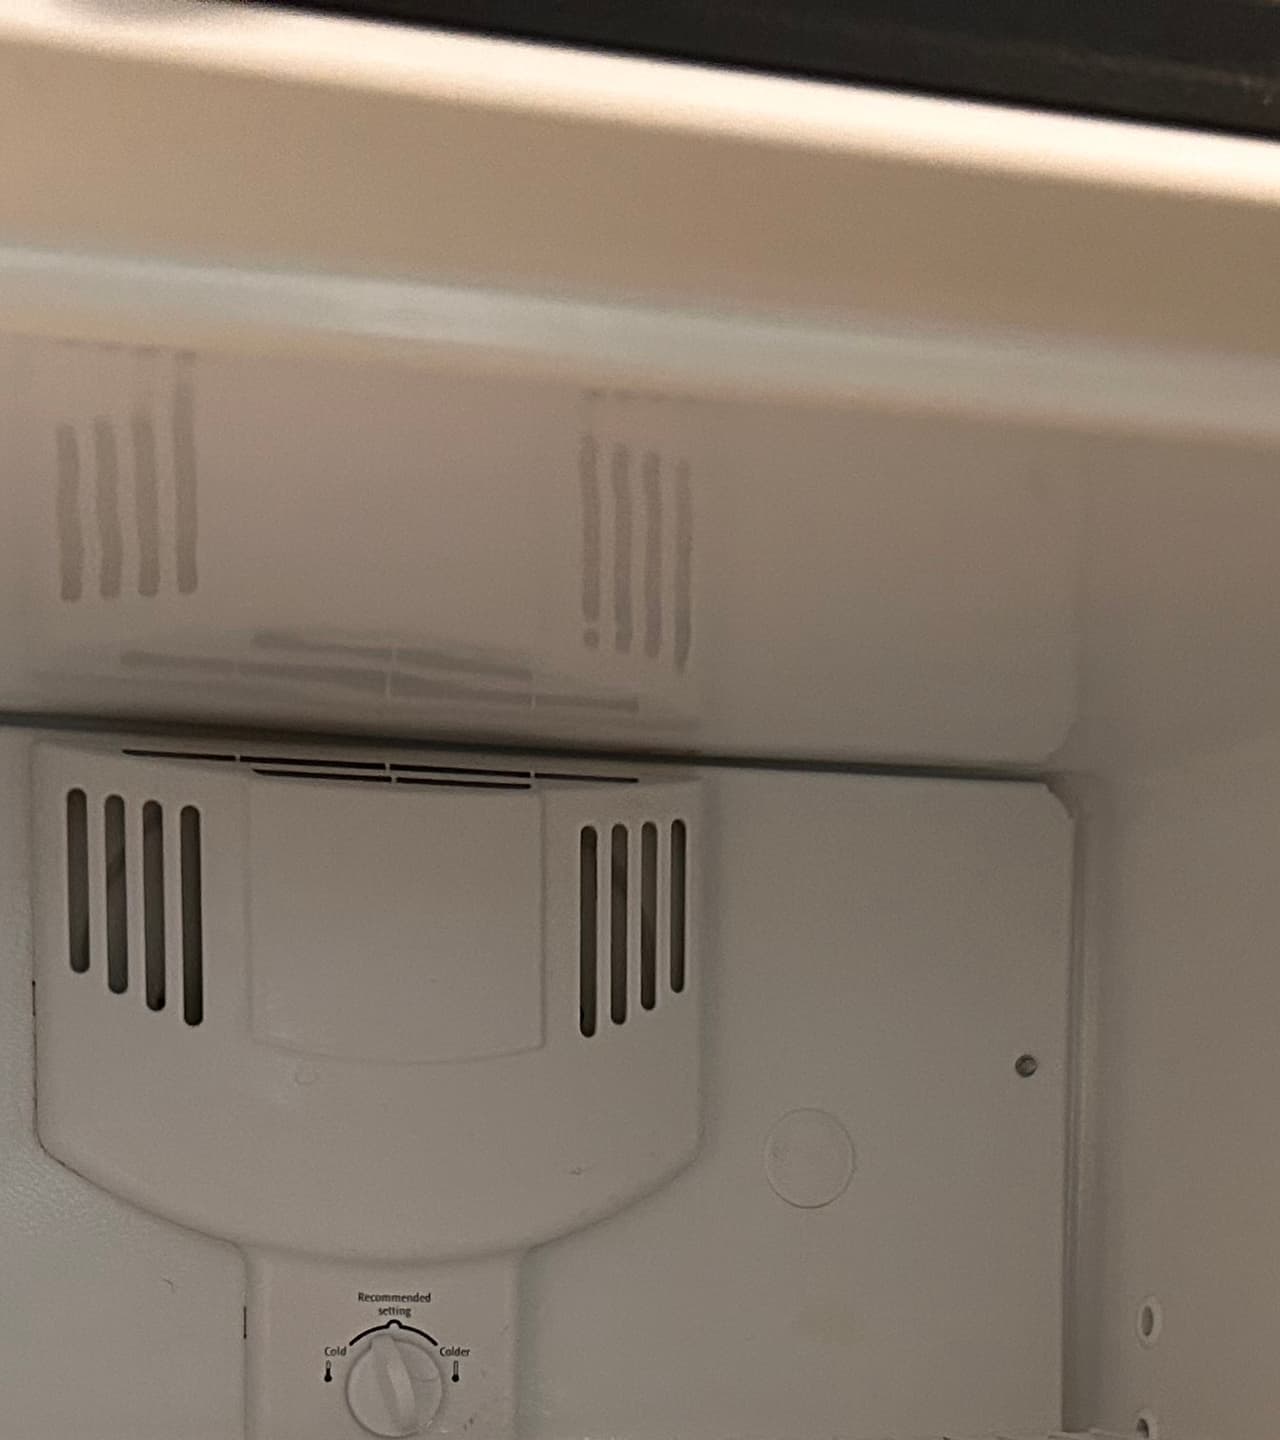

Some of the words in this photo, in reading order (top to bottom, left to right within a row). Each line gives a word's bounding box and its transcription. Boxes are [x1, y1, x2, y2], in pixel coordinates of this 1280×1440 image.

[358, 1292, 431, 1303] Recommended
[378, 1306, 411, 1317] setting
[324, 1347, 347, 1357] Cold
[440, 1347, 470, 1357] Colder
